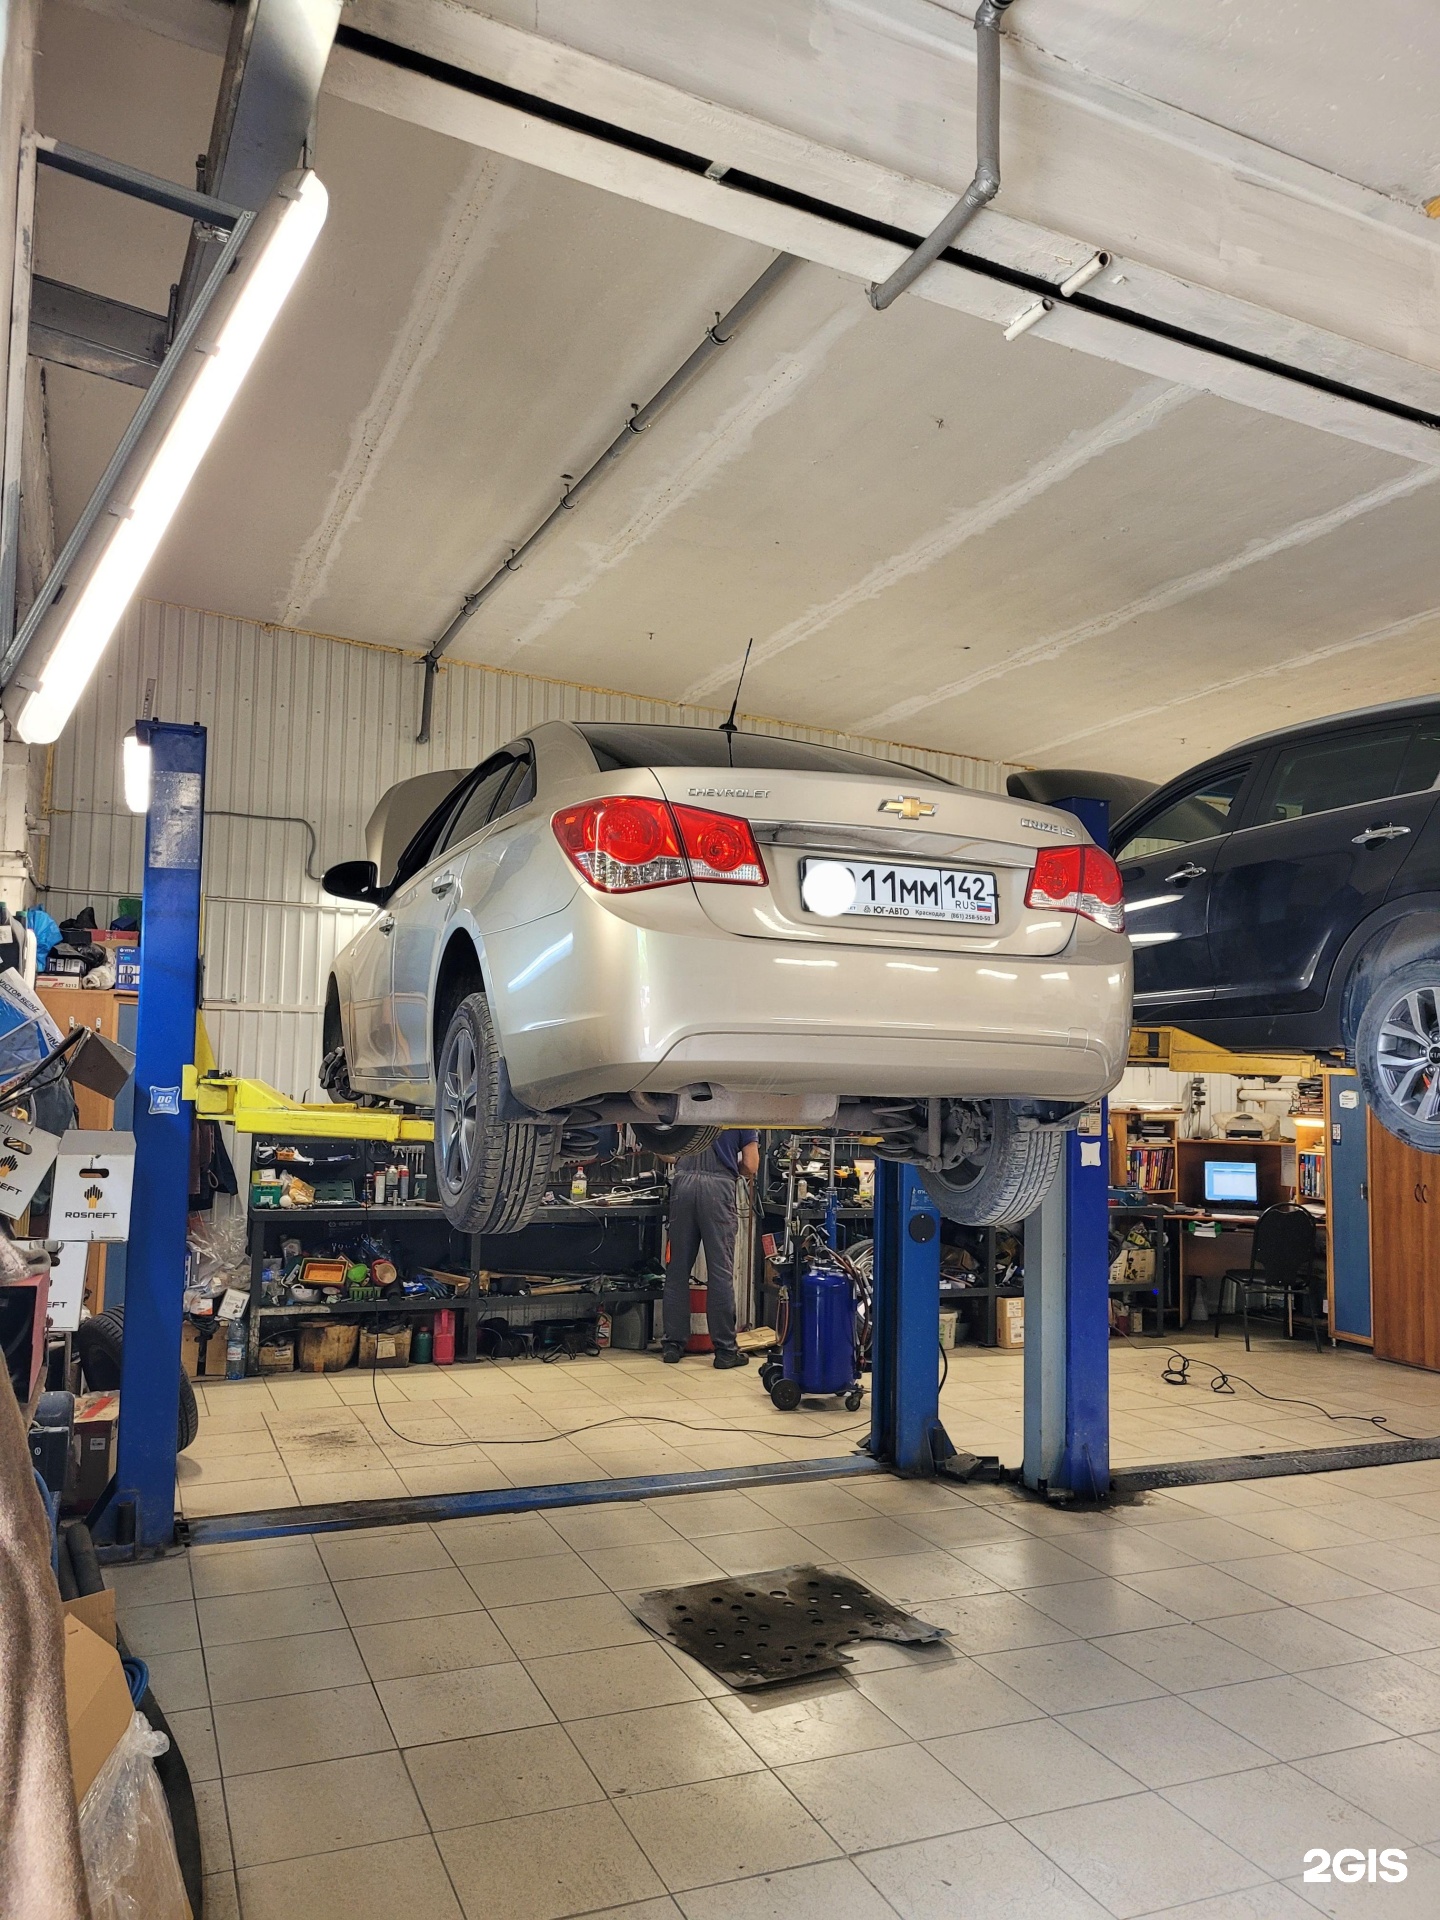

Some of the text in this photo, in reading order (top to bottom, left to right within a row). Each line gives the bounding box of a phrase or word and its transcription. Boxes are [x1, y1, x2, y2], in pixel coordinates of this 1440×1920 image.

[687, 788, 772, 799] CHEVROLET
[943, 874, 987, 902] 142
[873, 905, 910, 916] ЮГ-АВТО
[955, 900, 976, 910] RUS
[64, 1211, 118, 1219] ROSNEFT
